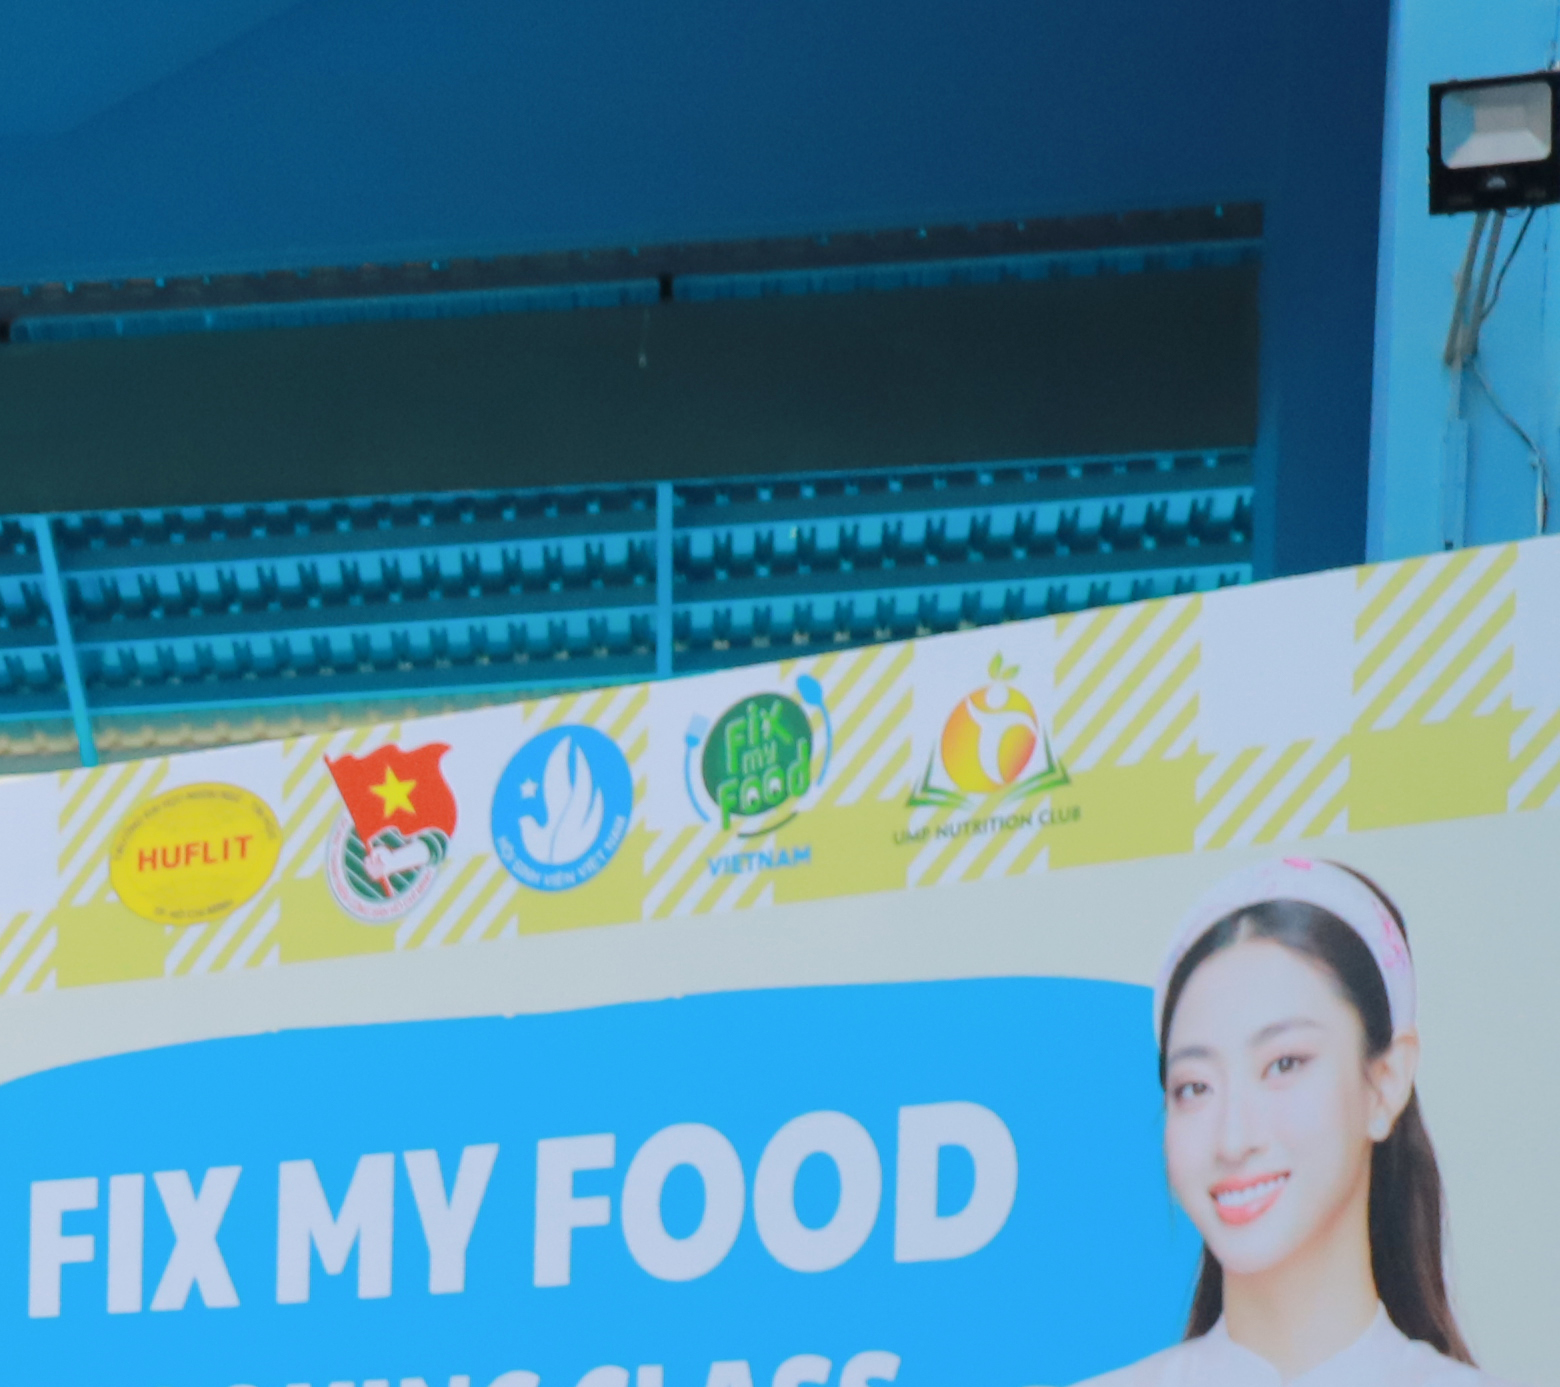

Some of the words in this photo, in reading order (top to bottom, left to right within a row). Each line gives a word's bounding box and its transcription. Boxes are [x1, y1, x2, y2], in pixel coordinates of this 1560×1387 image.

[893, 825, 931, 845] UMP
[936, 809, 1032, 839] NUTRITION
[1038, 806, 1082, 825] CLUB
[138, 834, 253, 872] HUFLIT
[708, 845, 811, 876] VIETNAM
[28, 1164, 243, 1319] FIX
[275, 1142, 500, 1305] MY
[533, 1100, 1019, 1288] FOOD
